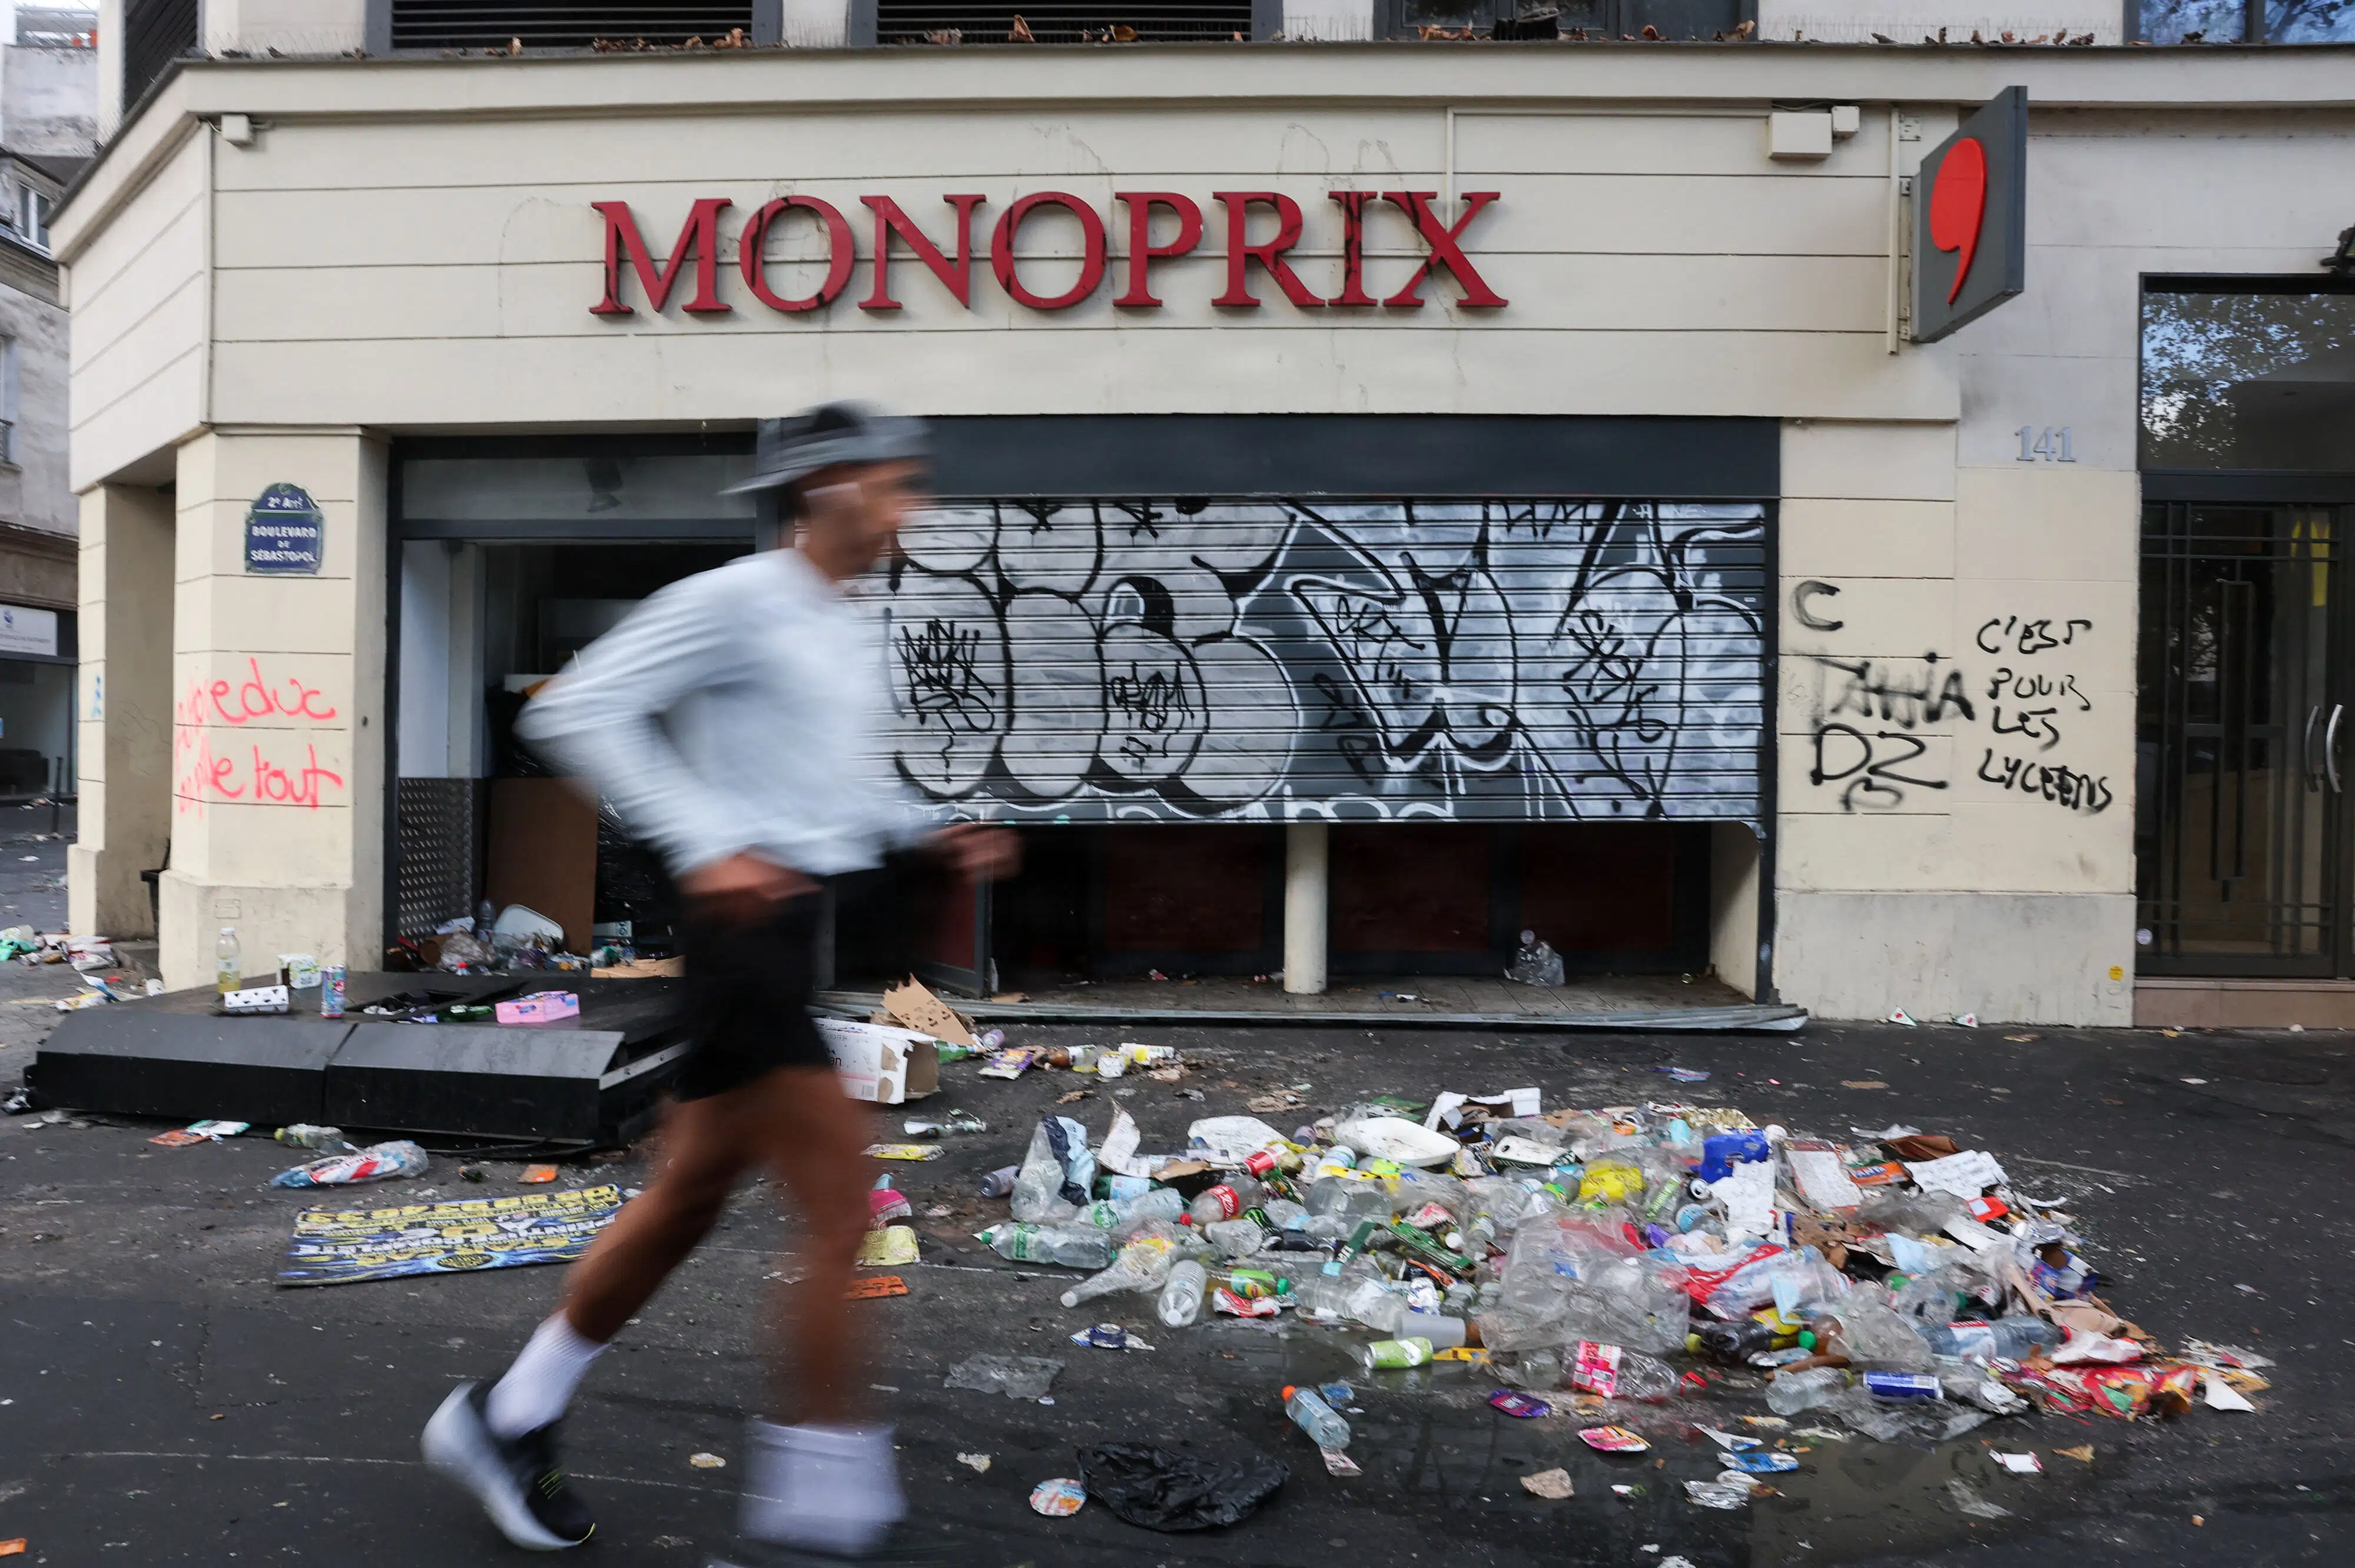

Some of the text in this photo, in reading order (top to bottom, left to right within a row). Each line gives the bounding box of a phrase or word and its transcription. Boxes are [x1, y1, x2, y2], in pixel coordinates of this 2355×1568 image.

[589, 191, 1508, 314] MONOPRIX
[2014, 426, 2077, 462] 141
[252, 526, 317, 538] BOULEVARD
[277, 540, 291, 549] DE
[1977, 615, 2092, 655] C'EST
[1987, 667, 2091, 711] POUR
[1992, 706, 2061, 752] LES
[1810, 723, 1949, 786] DZ
[253, 743, 344, 811] tout
